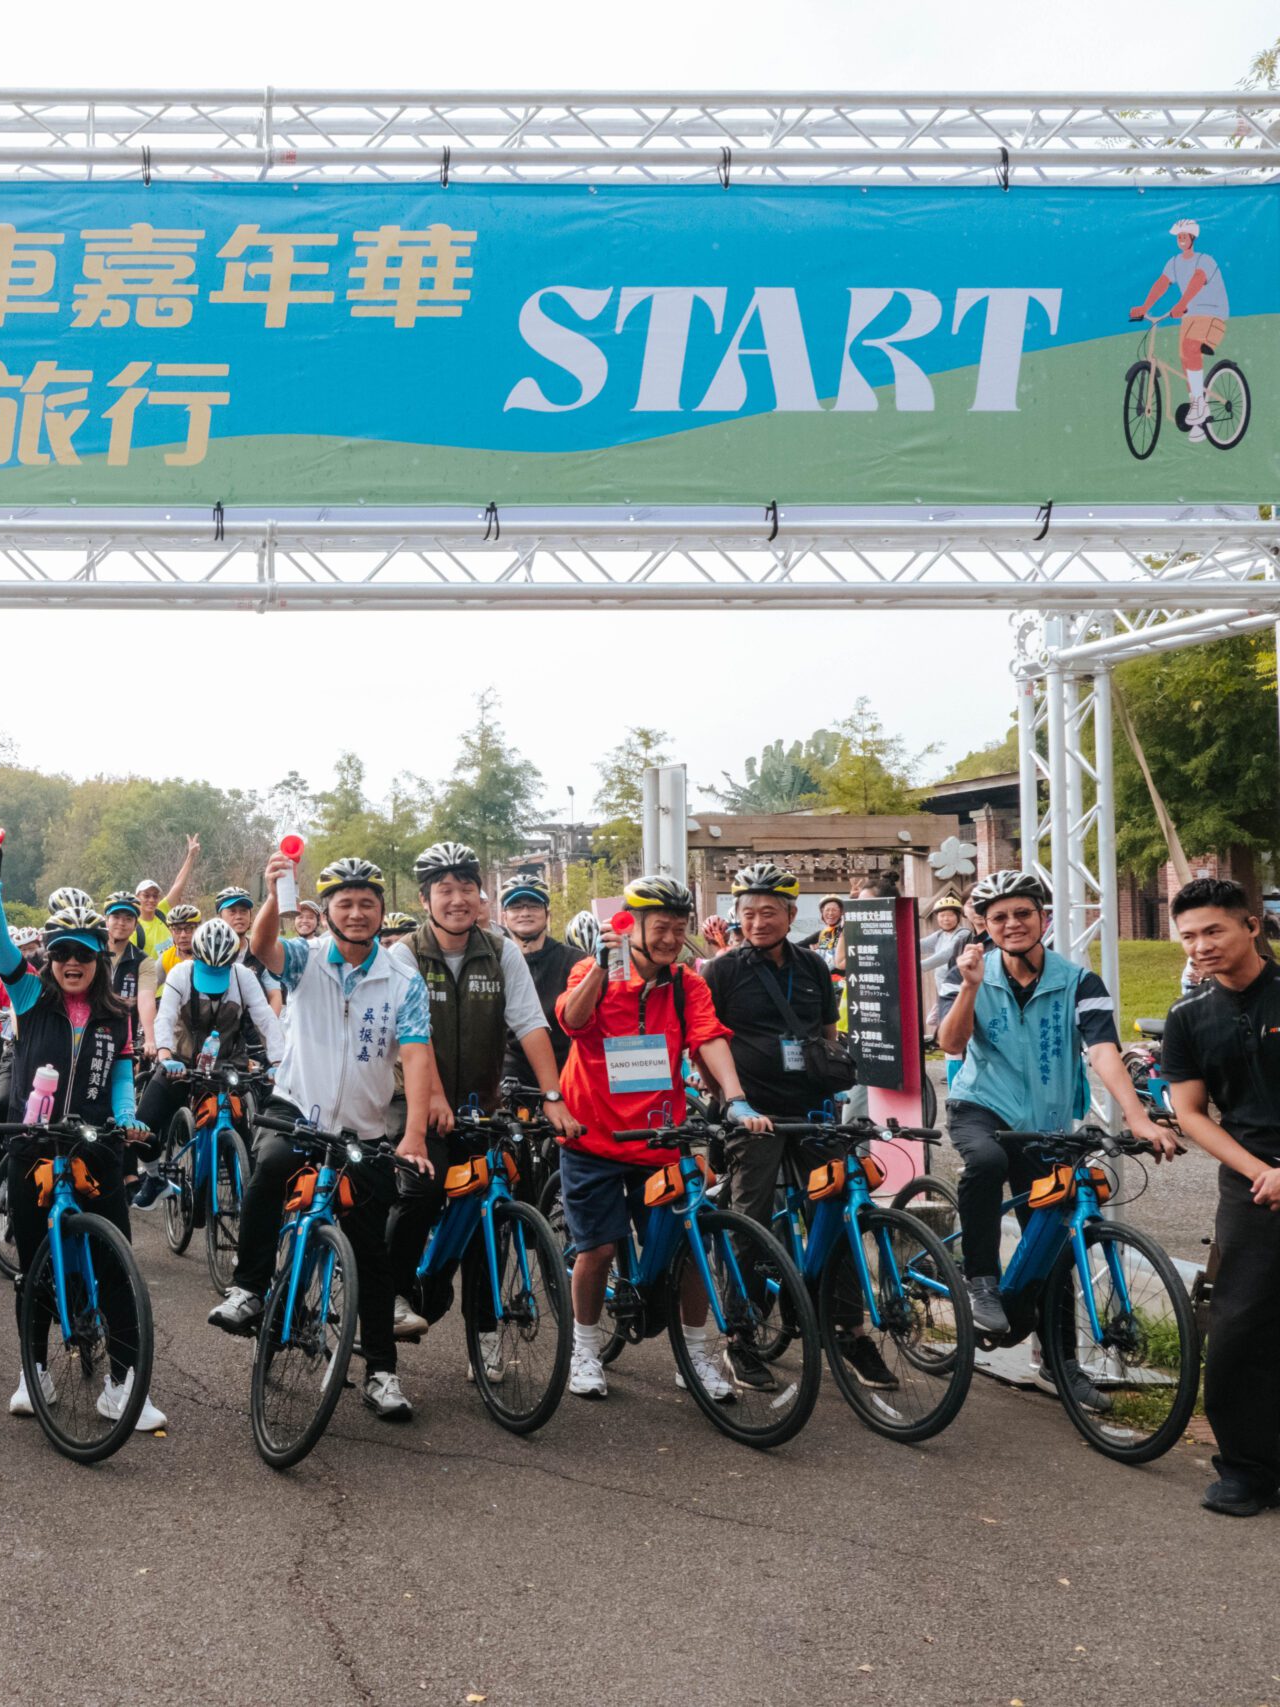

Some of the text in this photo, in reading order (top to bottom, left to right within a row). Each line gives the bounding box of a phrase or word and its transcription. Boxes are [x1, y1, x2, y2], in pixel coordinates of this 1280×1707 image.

[503, 284, 1063, 413] START
[610, 1059, 667, 1070] SANO HIDEFUMI
